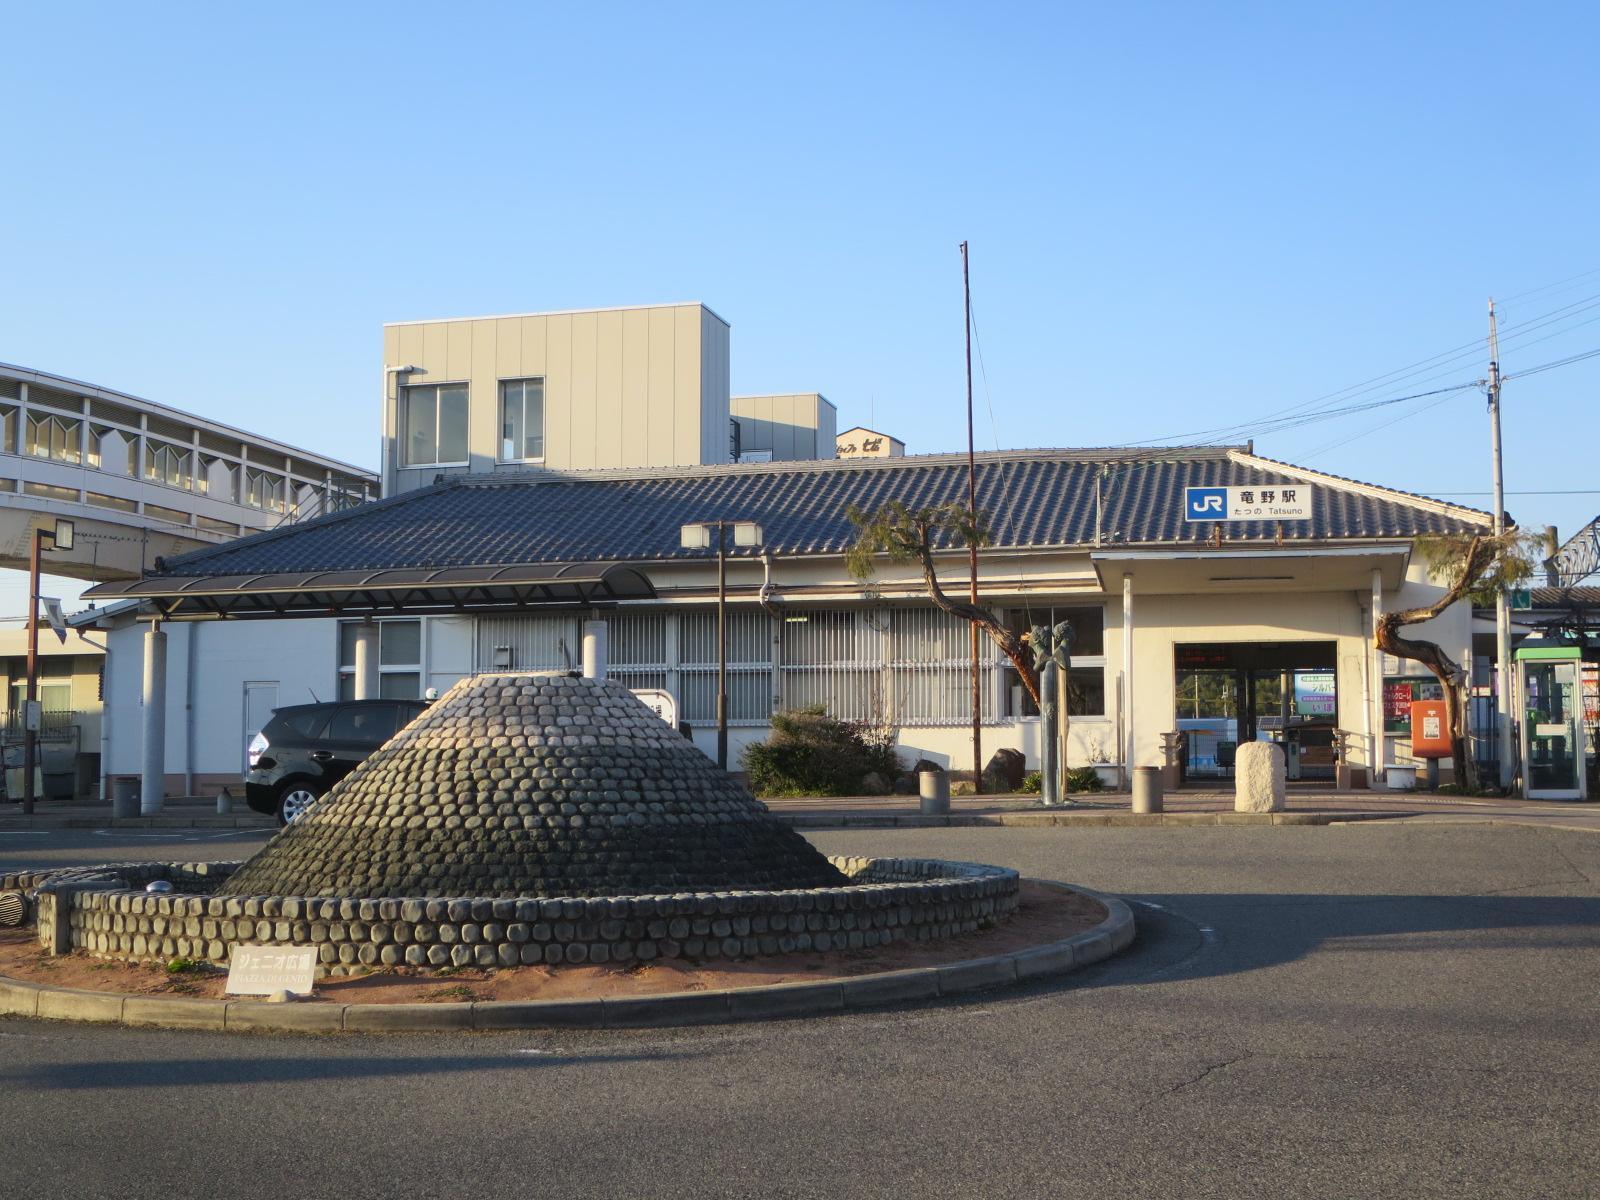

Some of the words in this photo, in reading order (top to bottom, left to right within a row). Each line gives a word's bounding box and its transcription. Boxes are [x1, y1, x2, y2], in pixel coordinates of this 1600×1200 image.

[1240, 490, 1297, 504] 竜野駅
[1193, 495, 1223, 512] JR
[1234, 507, 1263, 515] たつの
[1269, 507, 1303, 515] Tatsuno
